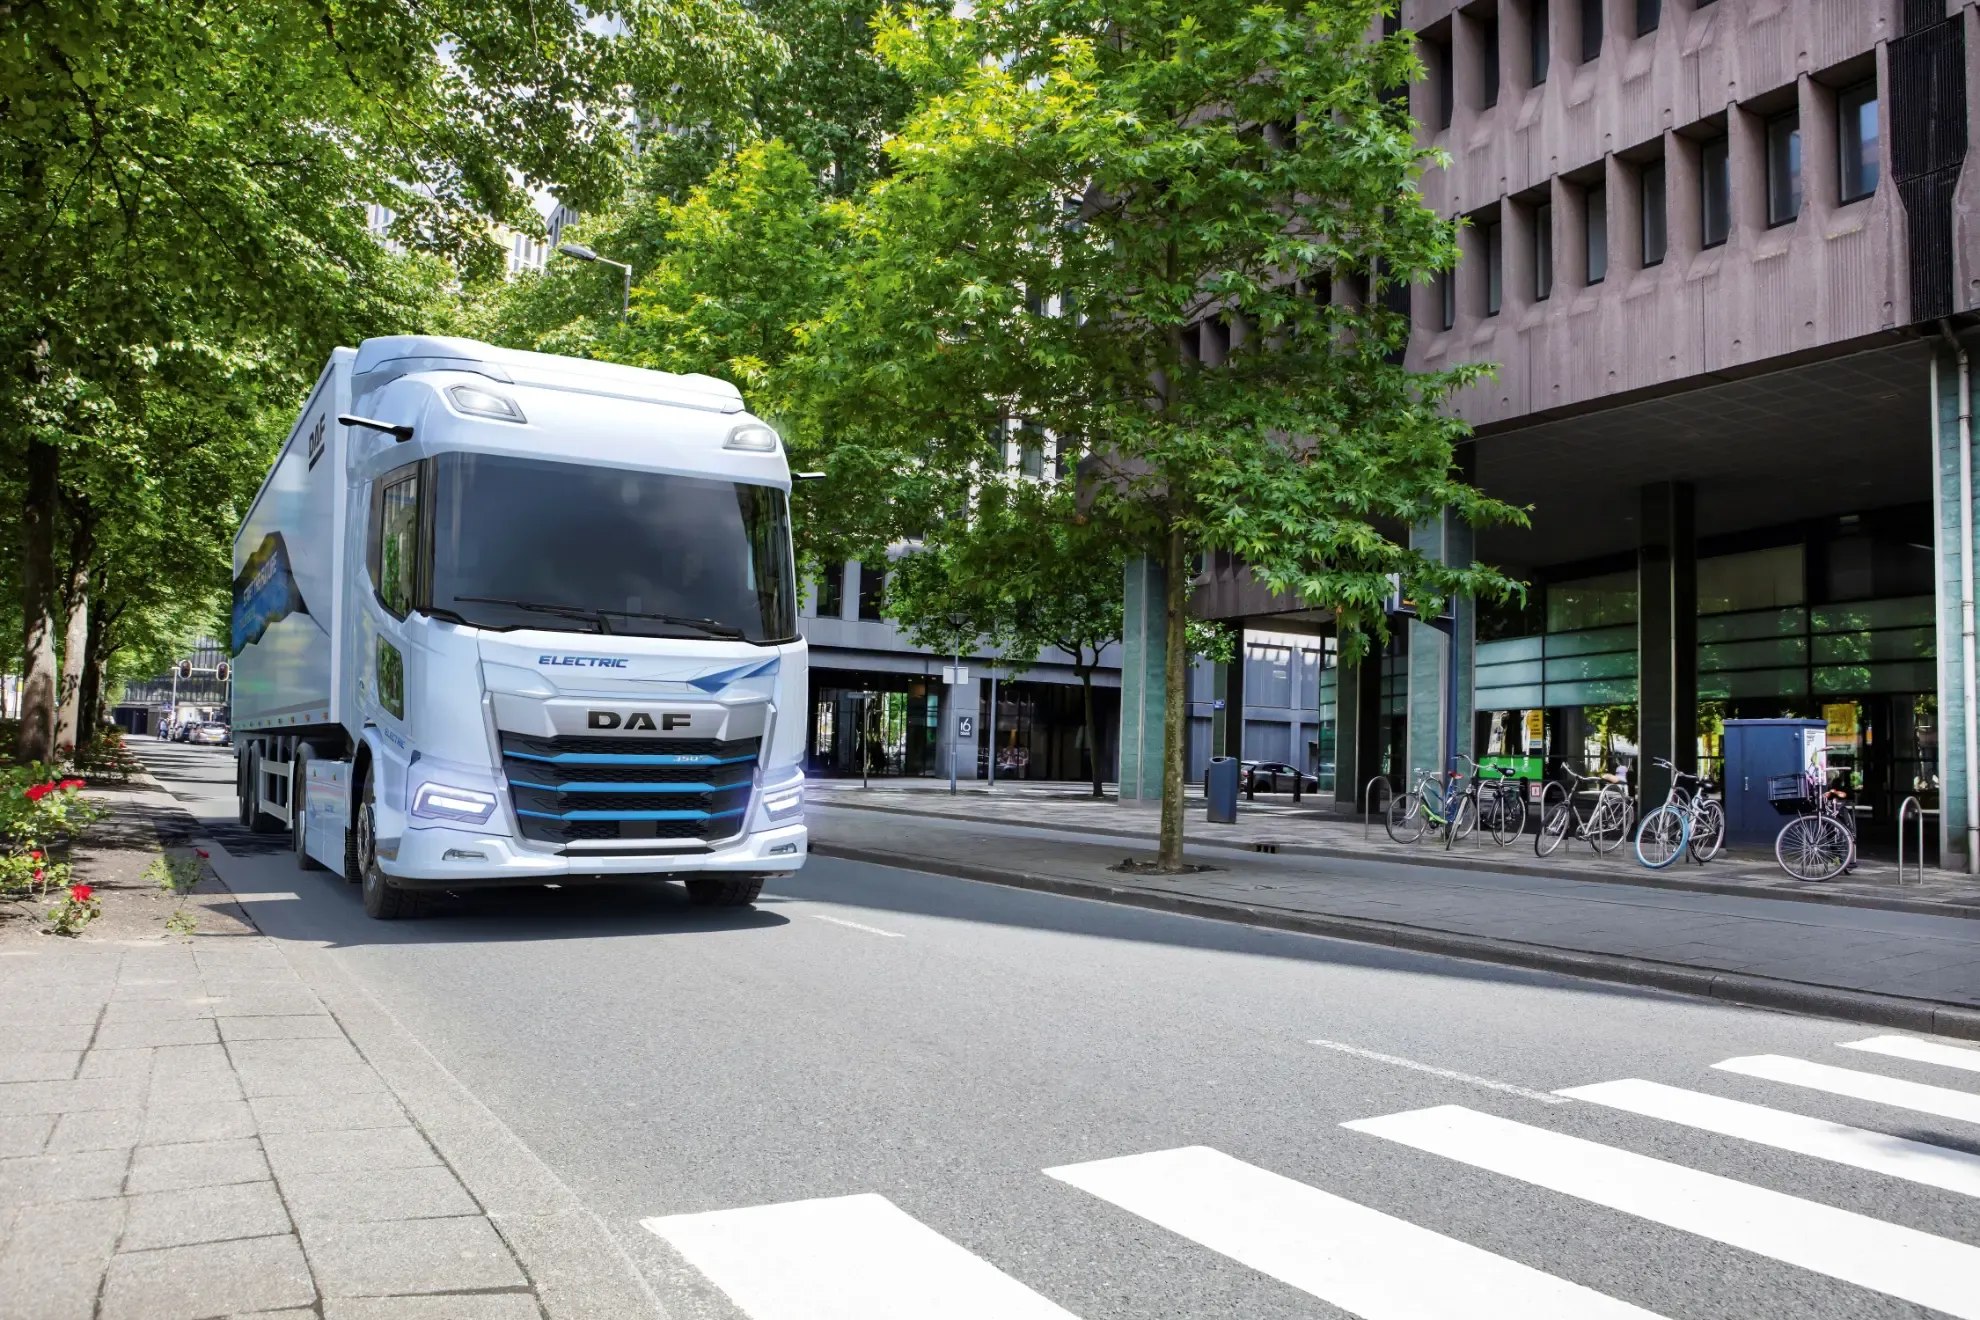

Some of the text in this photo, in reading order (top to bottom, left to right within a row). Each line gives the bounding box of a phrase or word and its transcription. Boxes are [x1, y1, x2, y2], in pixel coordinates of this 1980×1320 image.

[309, 411, 325, 459] DAF
[539, 655, 629, 668] ELECTRIC
[587, 710, 691, 731] DAF
[960, 717, 971, 731] 16
